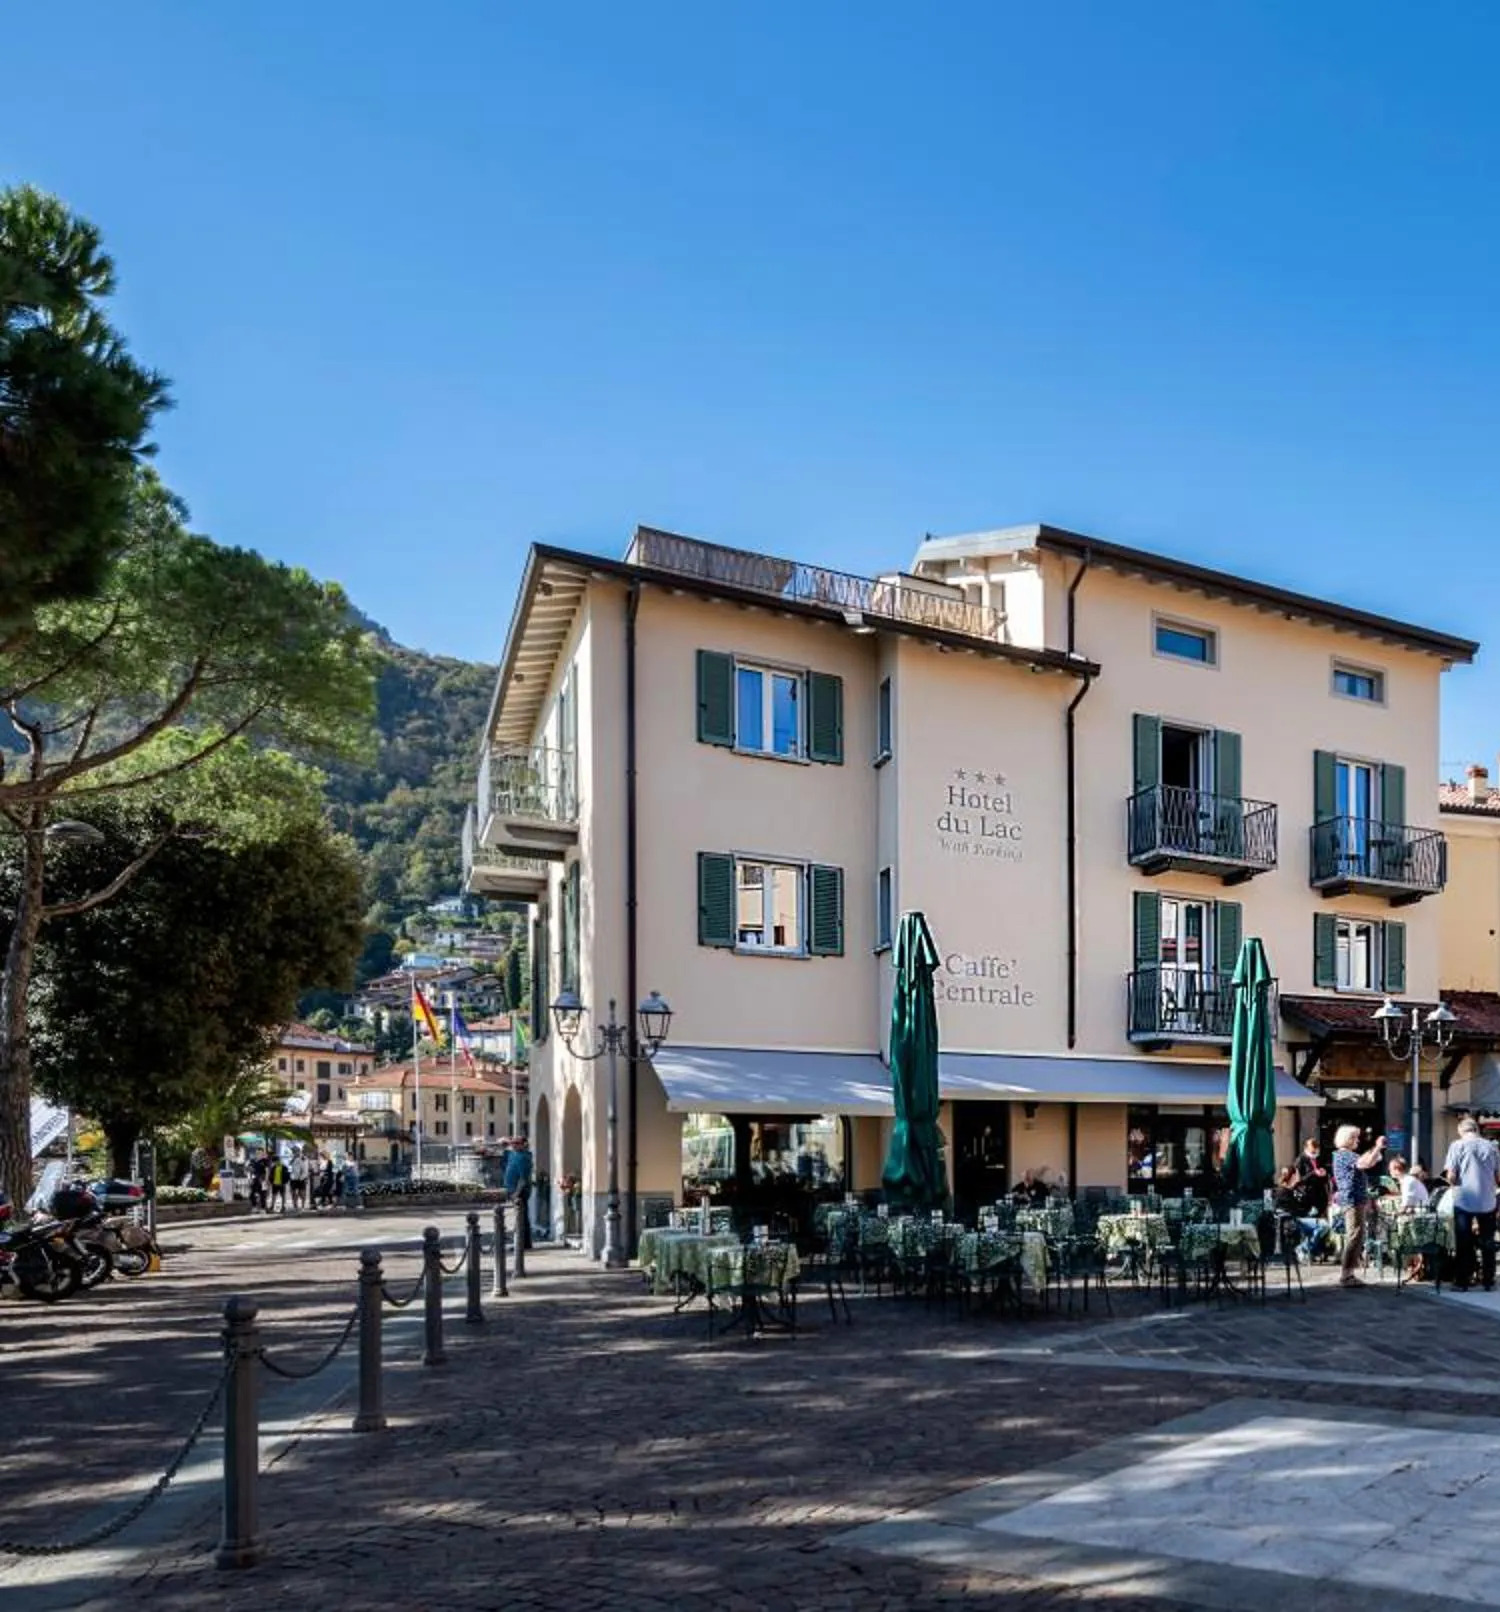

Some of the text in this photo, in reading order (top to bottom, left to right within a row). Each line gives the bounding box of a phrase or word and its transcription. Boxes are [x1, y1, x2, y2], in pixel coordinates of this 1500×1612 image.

[947, 785, 1012, 814] Hotel
[937, 811, 1023, 841] du Lac
